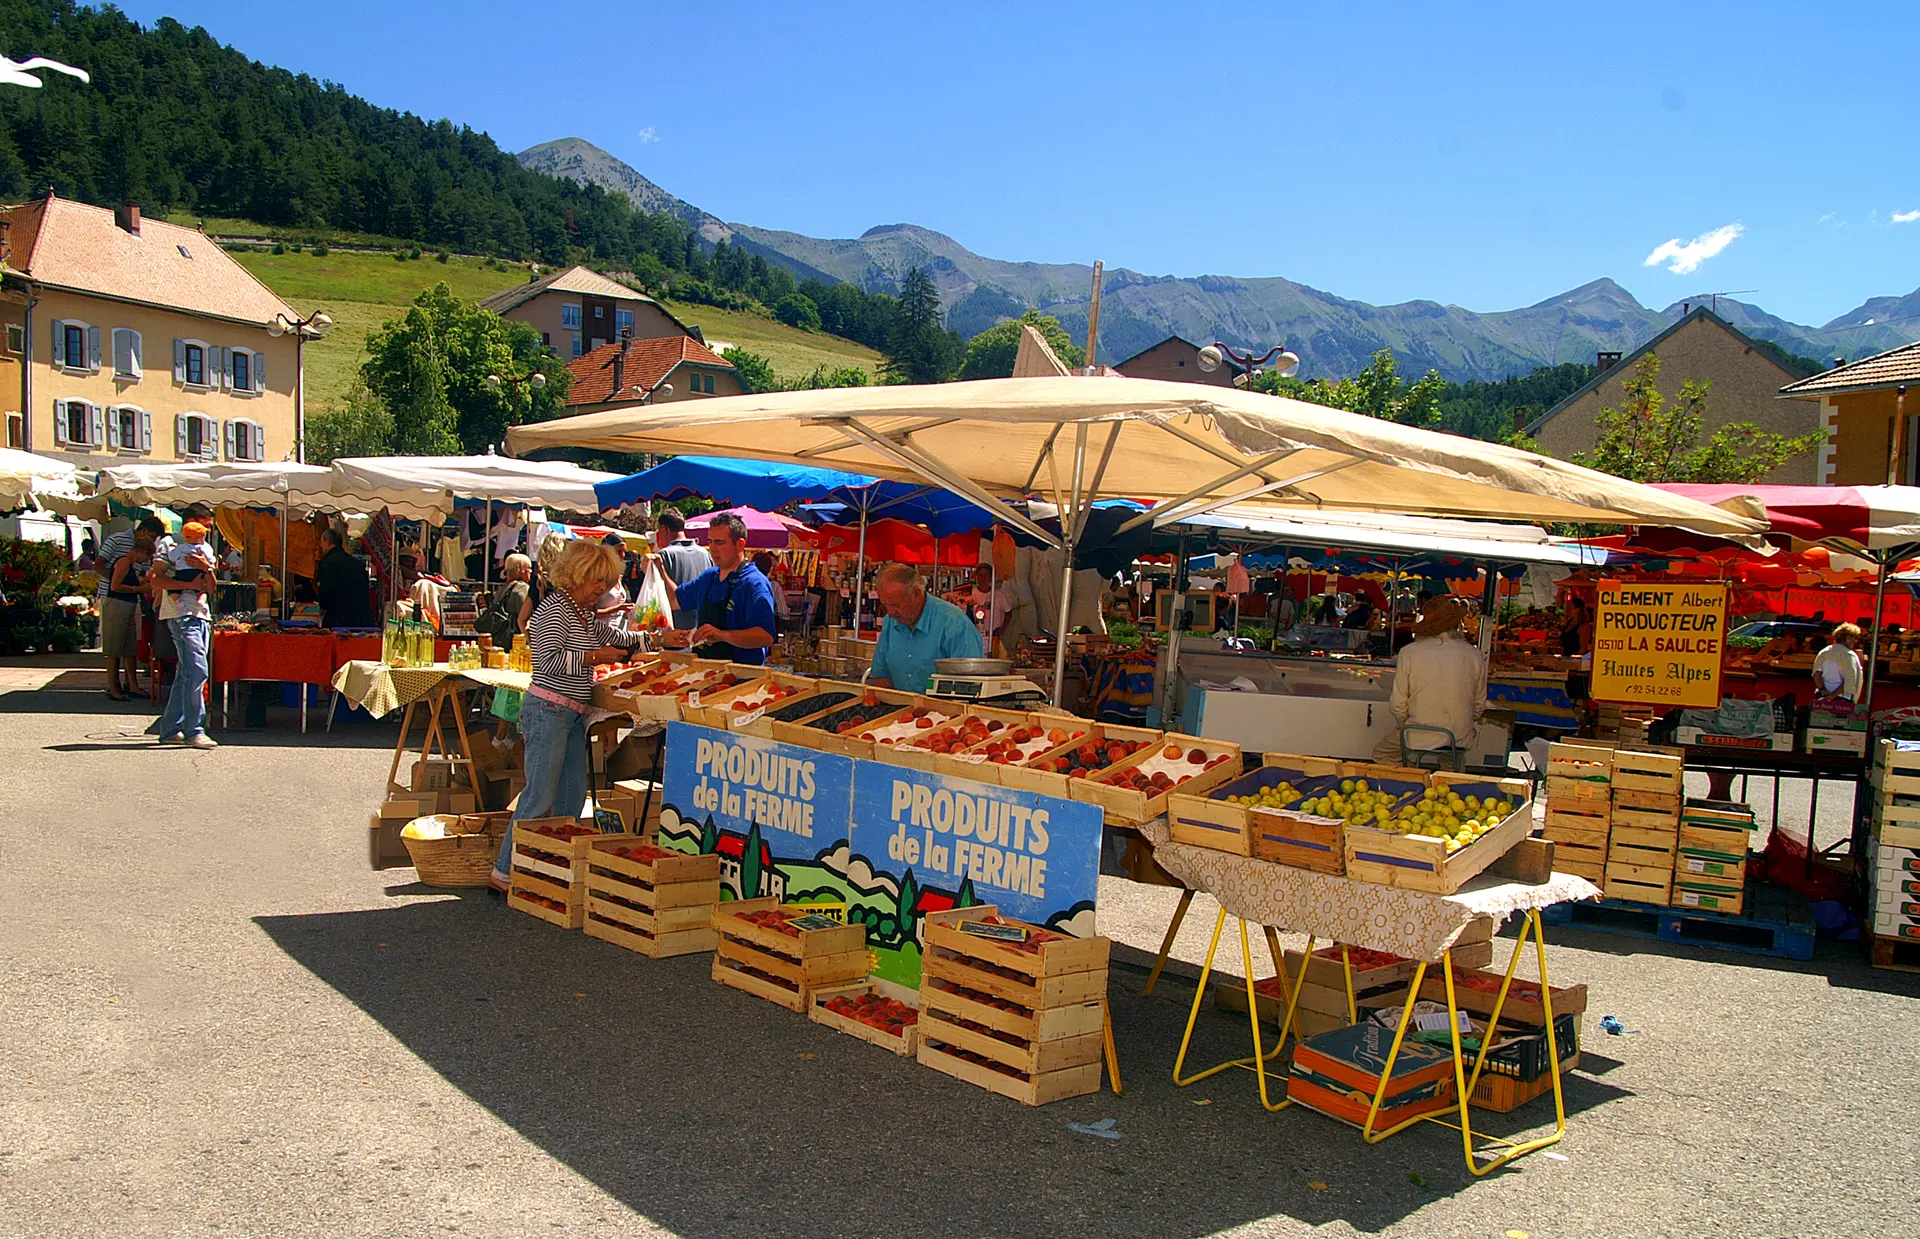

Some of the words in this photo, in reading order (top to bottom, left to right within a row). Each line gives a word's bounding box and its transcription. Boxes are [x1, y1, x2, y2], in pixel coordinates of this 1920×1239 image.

[1600, 591, 1674, 607] CLEMENT
[1681, 592, 1724, 607] Albert
[1603, 612, 1717, 632] PRODUCTEUR
[1598, 638, 1624, 651] 05110
[1628, 636, 1649, 651] LA
[1655, 637, 1718, 654] SAULCE
[1601, 659, 1655, 679] Hautes
[1666, 661, 1712, 684] Alpes
[695, 737, 816, 802] PRODUITS
[693, 780, 718, 810] de
[721, 781, 741, 818] la
[744, 788, 816, 839] FERME
[891, 779, 1050, 856] PRODUITS
[888, 823, 920, 861] de
[924, 829, 947, 871] la
[954, 838, 1048, 899] FERME
